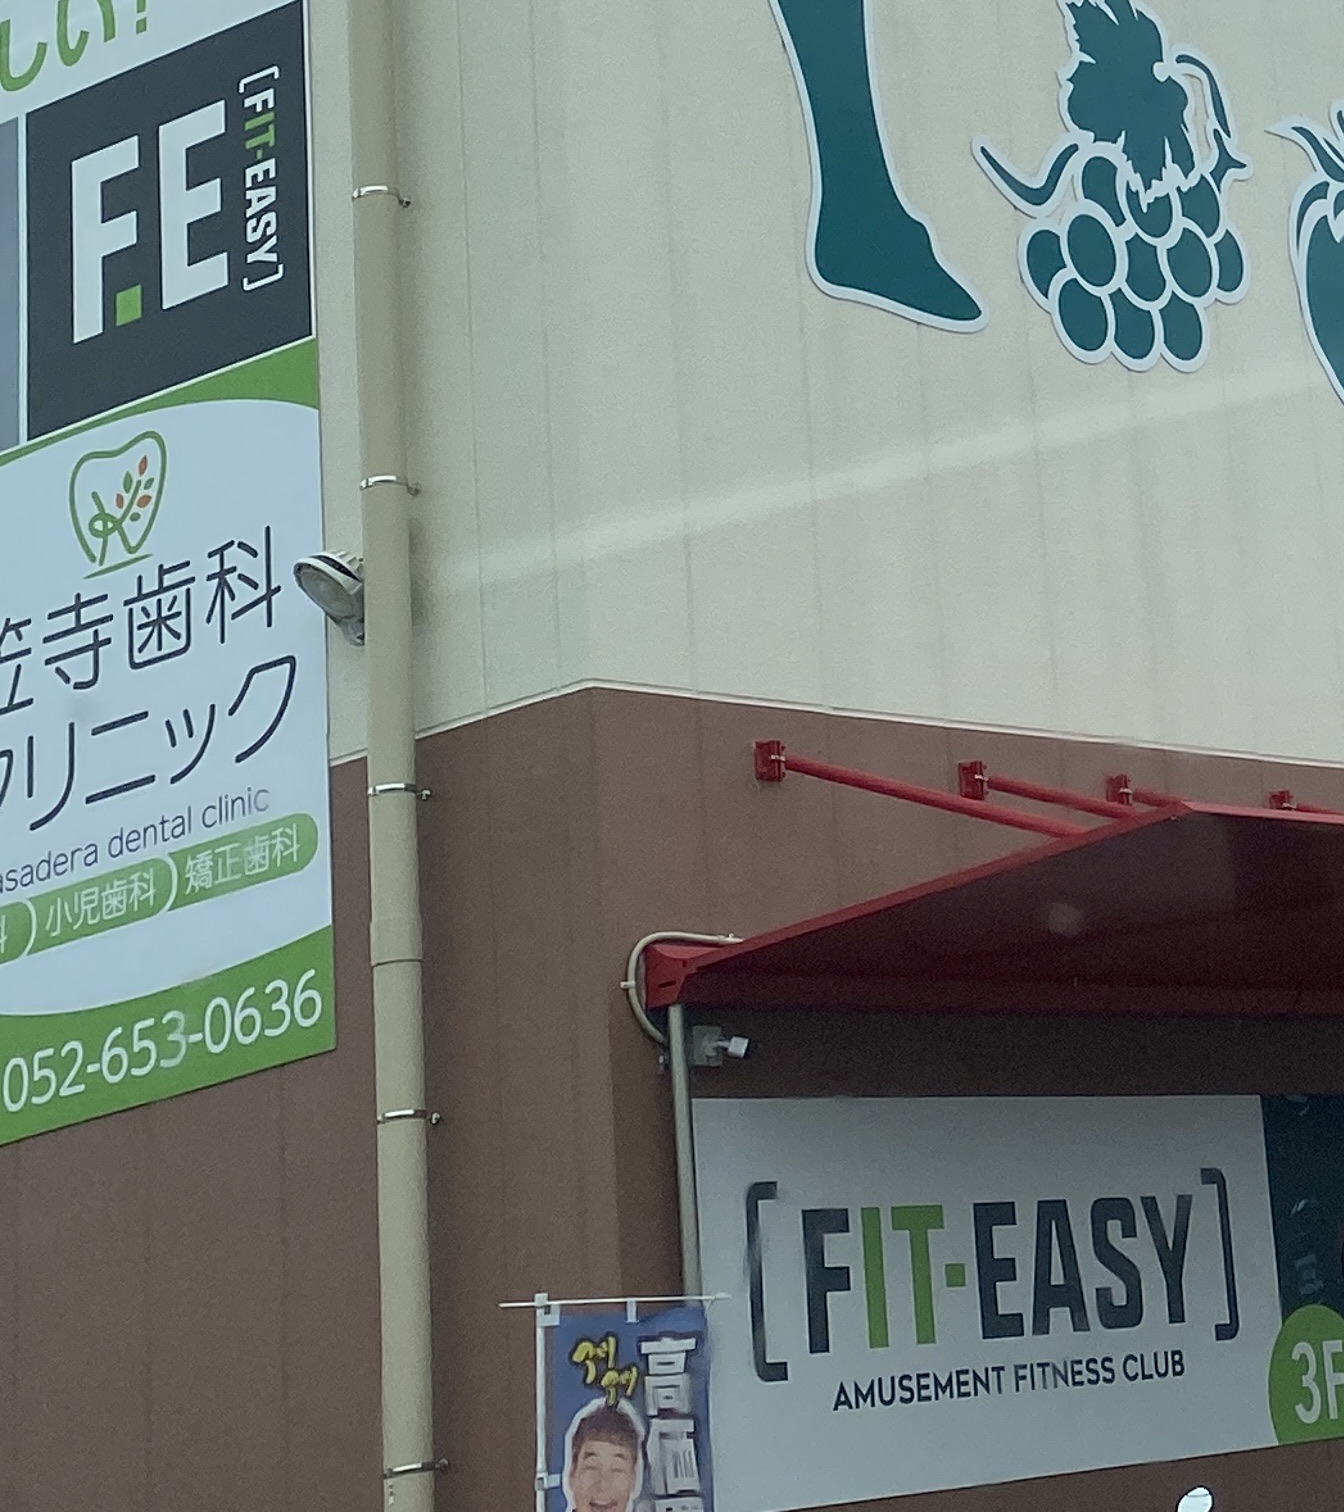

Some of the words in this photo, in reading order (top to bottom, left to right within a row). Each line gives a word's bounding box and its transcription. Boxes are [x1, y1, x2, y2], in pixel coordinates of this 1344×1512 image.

[0, 655, 296, 831] リニック
[0, 843, 98, 893] sadera
[108, 805, 191, 859] dental
[201, 786, 269, 829] clinic
[184, 823, 301, 895] 矯正歯科
[45, 867, 156, 937] 小児歯科
[3, 968, 323, 1113] 052-653-0636
[640, 1337, 703, 1512] 高価
[832, 1365, 1005, 1412] AMUSEMENT
[1014, 1355, 1115, 1394] FITNESS
[1122, 1349, 1185, 1382] CLUB
